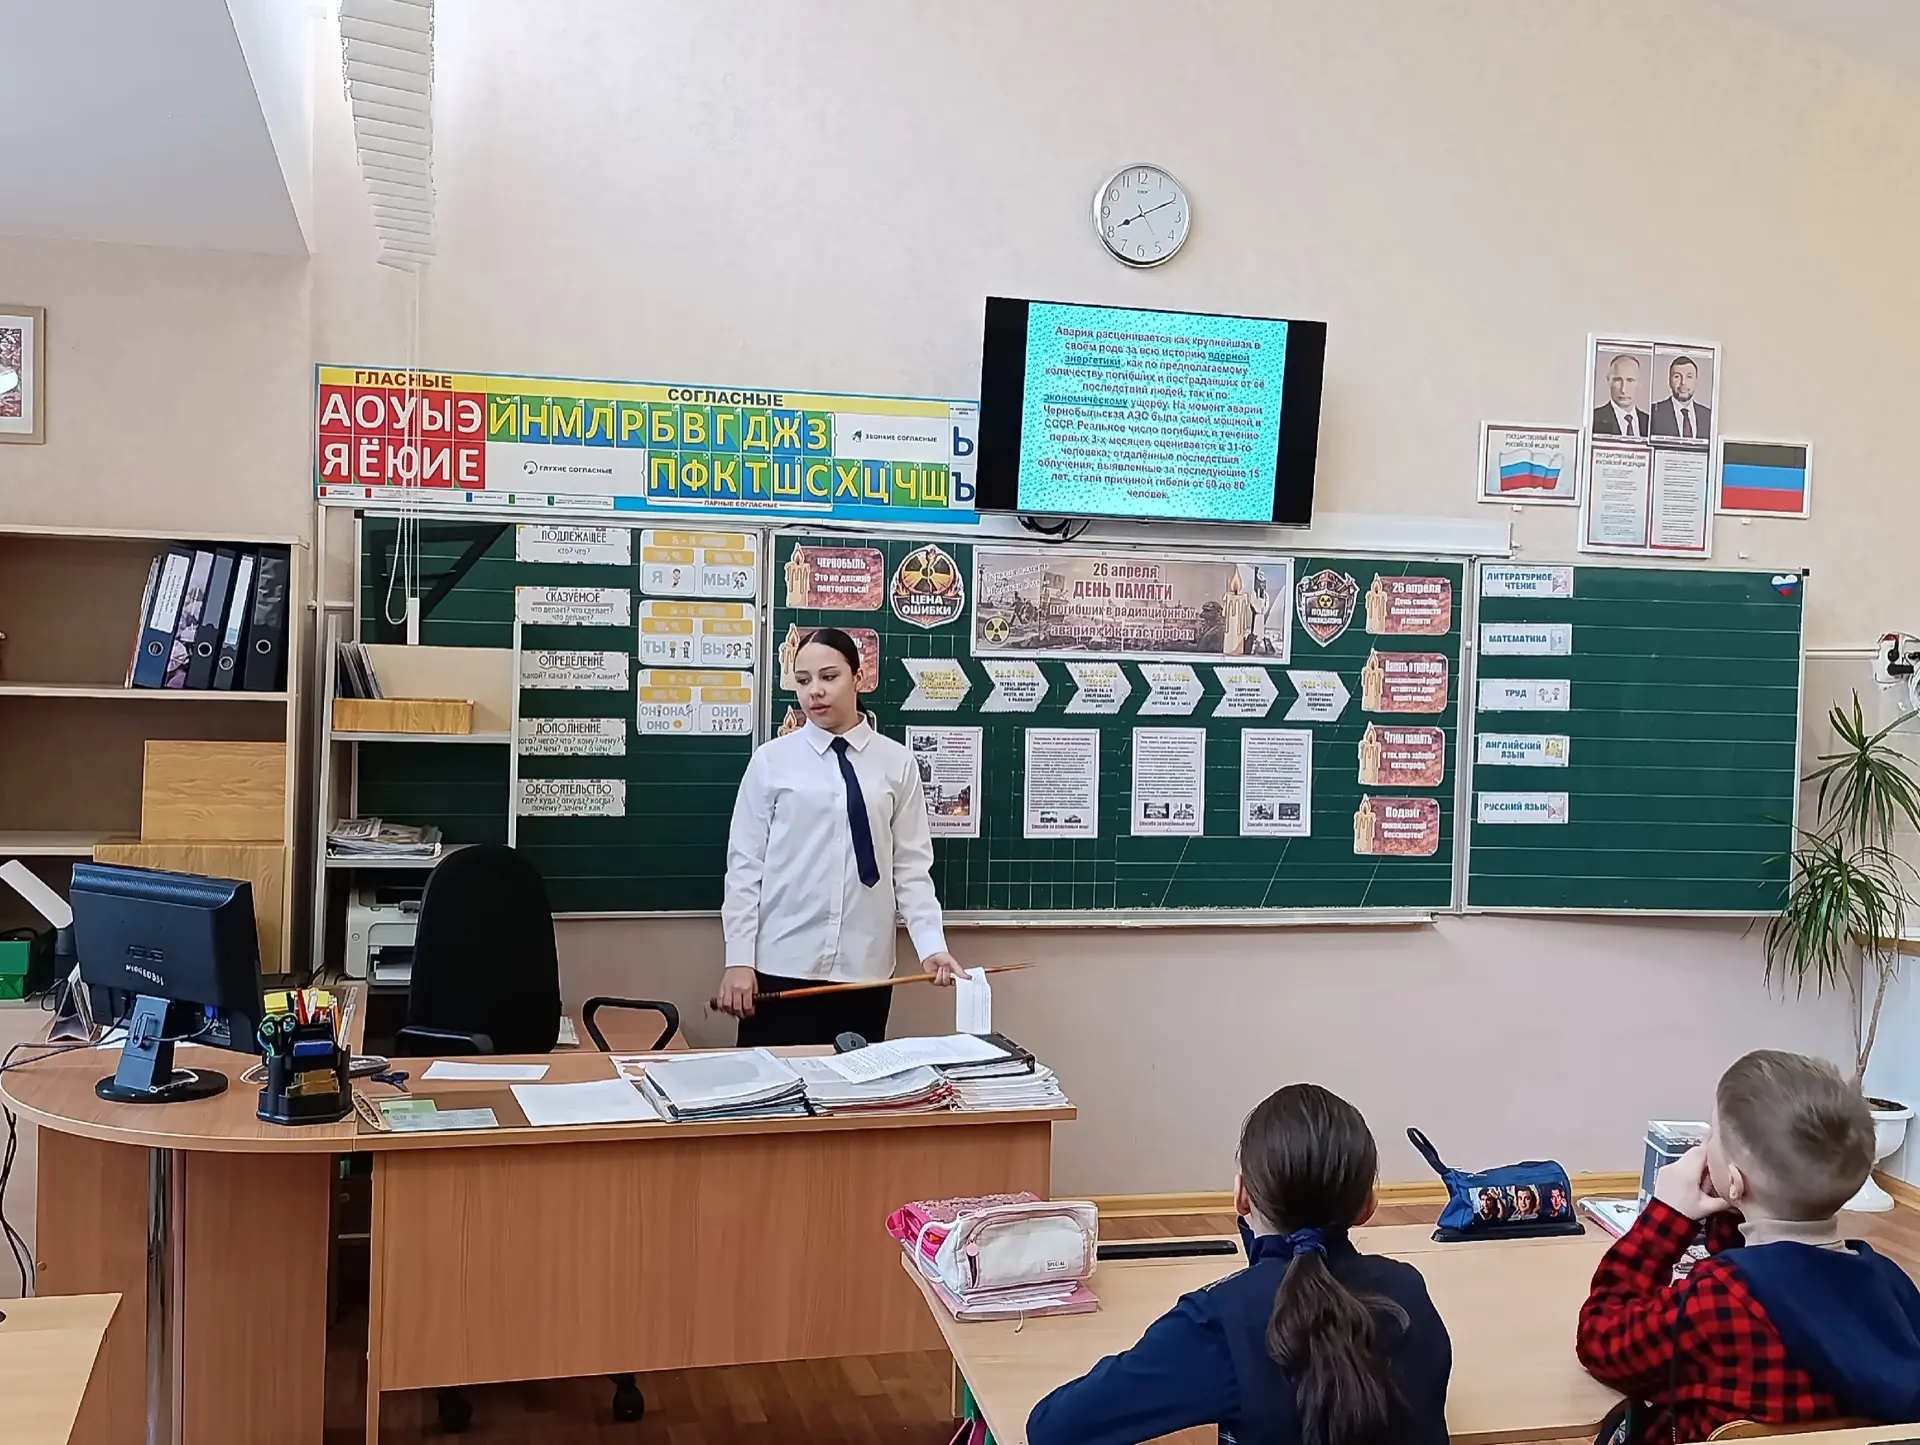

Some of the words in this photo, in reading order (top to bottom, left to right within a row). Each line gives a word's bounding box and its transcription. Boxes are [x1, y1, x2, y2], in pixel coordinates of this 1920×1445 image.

[1137, 171, 1148, 185] 12
[1108, 188, 1120, 201] 10
[1101, 205, 1111, 219] 9
[1174, 211, 1182, 224] 3
[1107, 225, 1115, 239] 8
[1167, 229, 1175, 241] 4
[1121, 239, 1128, 251] 7
[1154, 241, 1162, 254] 5
[1136, 245, 1145, 258] 6
[1055, 326, 1094, 338] Авария
[1174, 336, 1190, 345] как
[1127, 359, 1142, 368] как
[355, 371, 453, 389] ГЛАСНЫЕ
[667, 388, 784, 408] СОГЛАСНЫЕ
[1173, 400, 1185, 409] На
[1151, 412, 1177, 422] была
[865, 433, 896, 442] ЗВОНКИЕ
[897, 434, 938, 443] СОГЛАСНЫЕ
[539, 464, 567, 473] ГЛУХИЕ
[569, 466, 614, 475] СОГЛАСНЫЕ
[704, 500, 734, 508] ПАРНЫЕ
[735, 501, 778, 509] СОГЛАСНЫЕ
[541, 530, 607, 543] ПОДЛЕЖАЩЕЕ
[557, 547, 573, 555] кто?
[574, 547, 591, 556] что?
[1093, 563, 1108, 577] 26
[1111, 565, 1158, 580] апреля
[1487, 572, 1553, 581] ЛИТЕРАТУРНОЕ
[652, 570, 663, 584] Я
[703, 572, 730, 586] МЫ
[814, 573, 829, 582] Это
[817, 584, 870, 594] повториться!
[1072, 581, 1111, 600] ДЕНЬ
[1115, 582, 1173, 600] ПАМЯТИ
[1392, 582, 1405, 593] 26
[1405, 583, 1442, 594] апреля
[1504, 582, 1537, 590] ЧТЕНИЕ
[545, 591, 600, 603] СКАЗУЕМОЕ
[910, 594, 943, 606] ЦЕНА
[543, 606, 570, 614] делает?
[583, 607, 614, 615] сделает?
[901, 605, 952, 615] ОШИБКИ
[1051, 605, 1103, 619] погибших
[1106, 607, 1112, 616] в
[1114, 607, 1196, 620] радиационных
[564, 614, 594, 622] делают?
[1051, 625, 1102, 638] авариях
[1102, 626, 1112, 636] и
[1114, 626, 1195, 640] катастрофах
[1488, 634, 1547, 643] МАТЕМАТИКА
[643, 640, 666, 654] ТЫ
[702, 642, 726, 656] ВЫ
[538, 654, 605, 667] ОПРЕДЕЛЕНИЕ
[522, 671, 547, 680] какой?
[548, 671, 572, 680] какая?
[572, 672, 595, 680] какое?
[596, 672, 620, 680] какие?
[1504, 689, 1527, 698] ТРУД
[641, 706, 657, 716] ОН
[662, 707, 685, 717] ОНА
[711, 706, 739, 717] ОНИ
[535, 722, 602, 735] ДОПОЛНЕНИЕ
[646, 720, 670, 730] ОНО
[538, 737, 559, 745] чего?
[560, 737, 576, 745] что?
[577, 737, 599, 746] кому?
[599, 737, 620, 746] чему?
[1485, 740, 1542, 750] АНГЛИЙСКИЙ
[525, 745, 542, 753] кем?
[543, 745, 561, 753] чем?
[1500, 751, 1525, 759] ЯЗЫК
[525, 783, 612, 794] ОБСТОЯТЕЛЬСТВО
[521, 797, 538, 805] где?
[539, 797, 561, 805] куда?
[561, 797, 590, 805] откуда?
[590, 796, 615, 805] когда?
[1483, 801, 1523, 811] РУССКИЙ
[1524, 803, 1548, 811] ЯЗЫК
[532, 804, 562, 812] почему?
[562, 804, 588, 812] зачем?
[588, 804, 605, 812] как?
[1385, 806, 1421, 819] Подвиг
